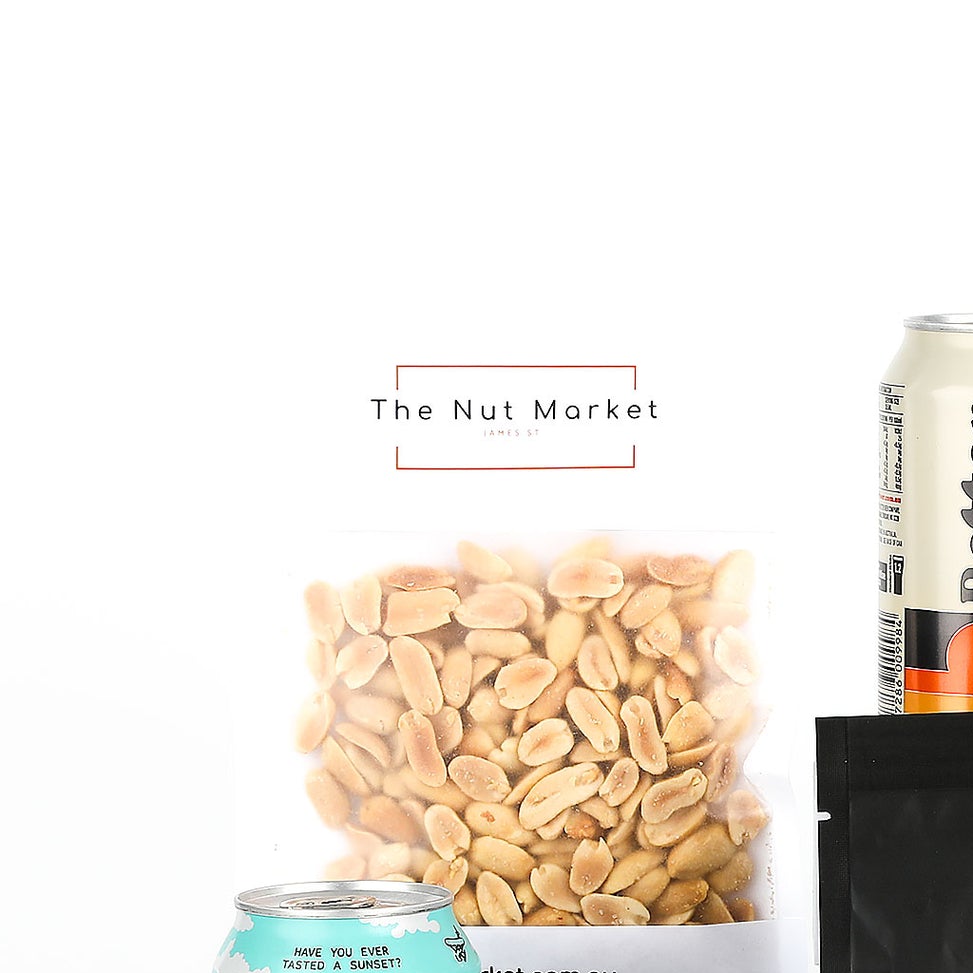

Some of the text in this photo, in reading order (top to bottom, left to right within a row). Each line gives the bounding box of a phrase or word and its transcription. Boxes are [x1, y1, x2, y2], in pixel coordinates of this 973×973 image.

[370, 398, 658, 421] The Nut Market
[893, 680, 903, 713] 7286
[294, 946, 390, 957] HAVE YOU EVER
[283, 957, 402, 970] TASTED A SUNSET?
